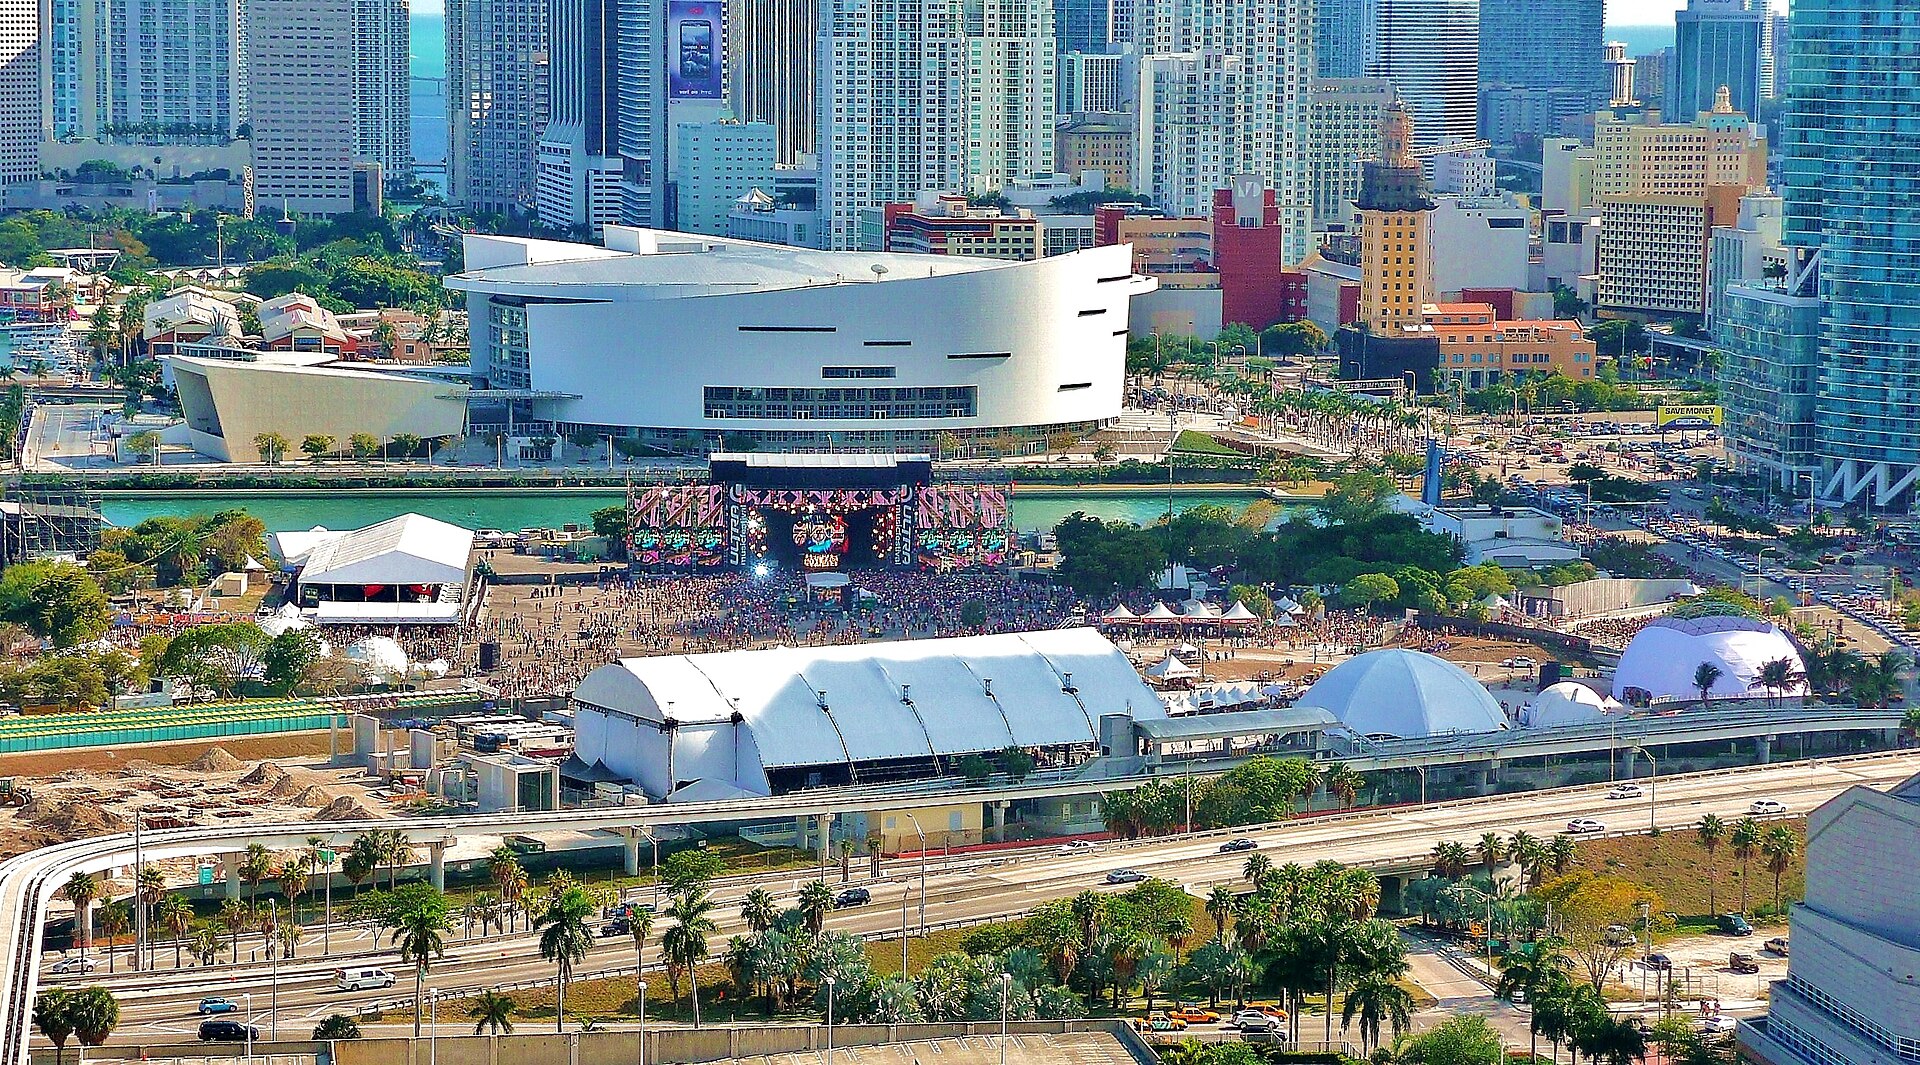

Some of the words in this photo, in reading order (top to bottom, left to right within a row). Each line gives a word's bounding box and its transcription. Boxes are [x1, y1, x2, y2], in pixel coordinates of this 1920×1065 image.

[1665, 407, 1685, 415] SAVE
[1685, 407, 1715, 415] MONEY
[729, 504, 740, 566] ULTRA
[901, 504, 912, 565] ULTRA
